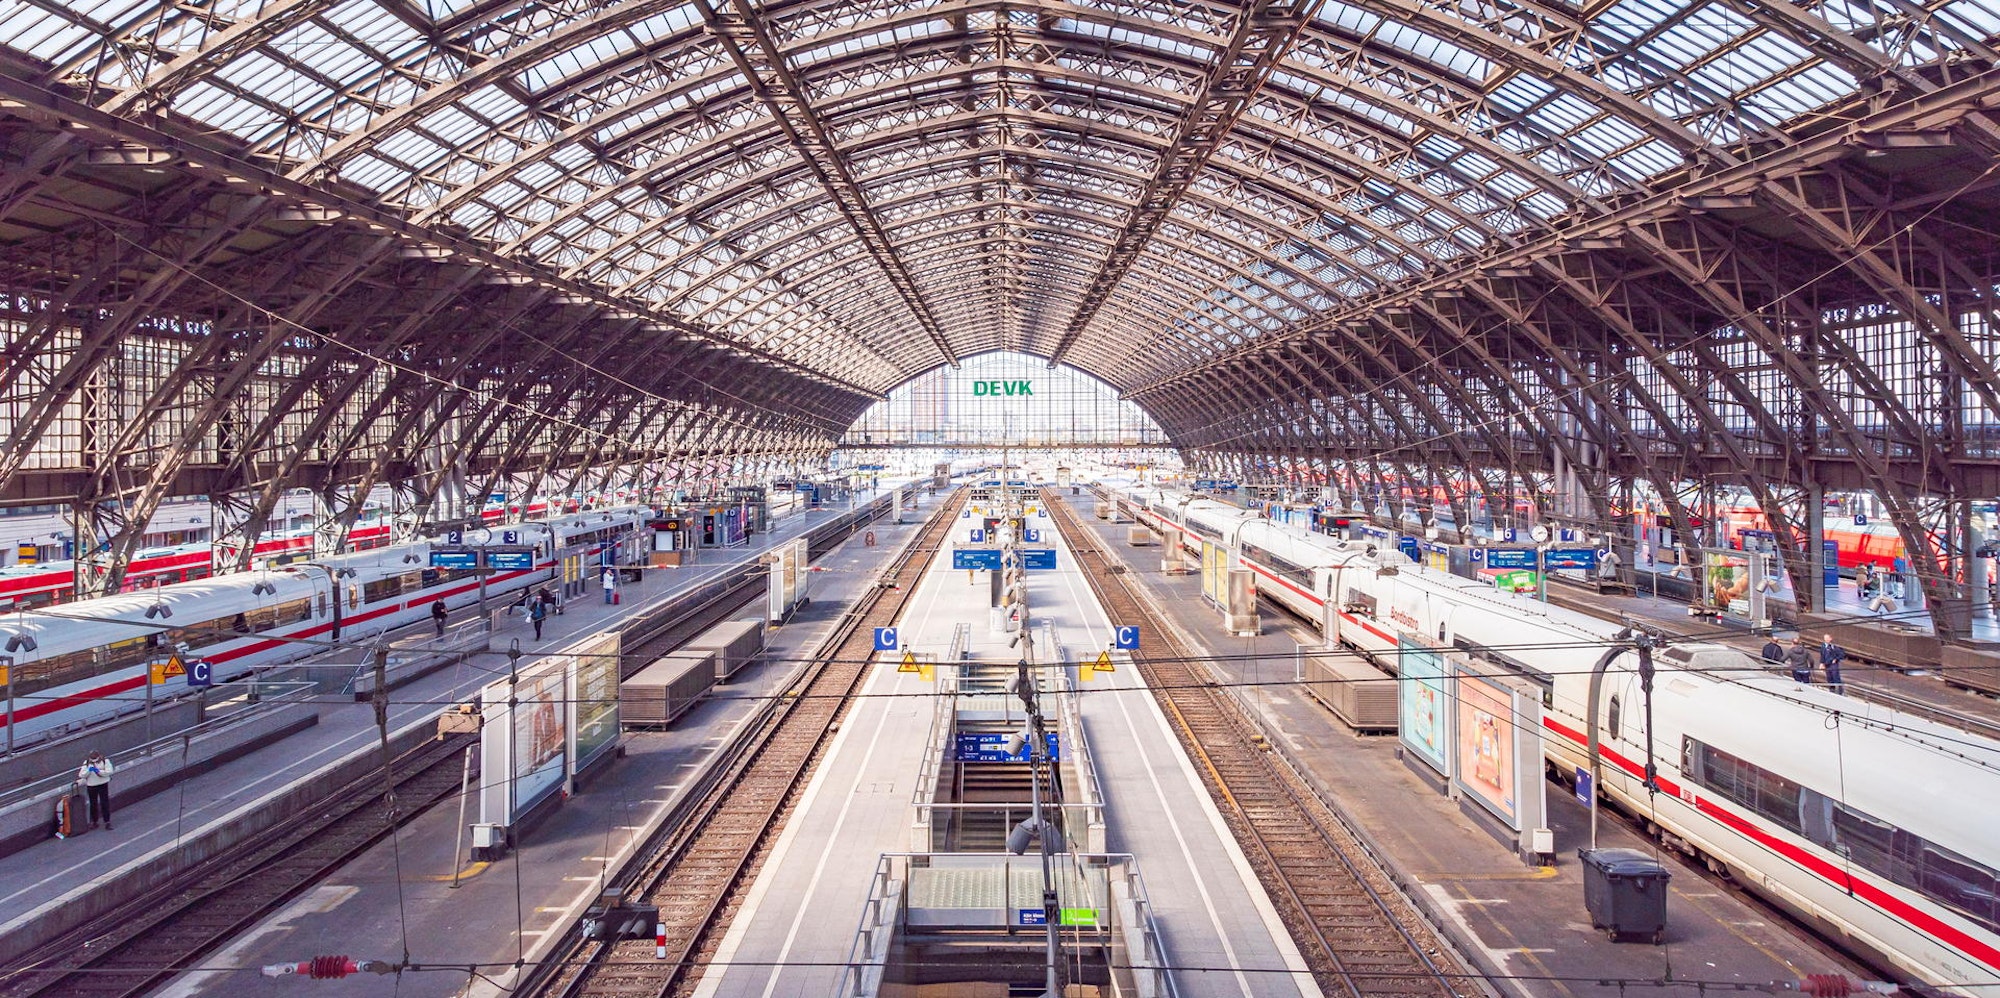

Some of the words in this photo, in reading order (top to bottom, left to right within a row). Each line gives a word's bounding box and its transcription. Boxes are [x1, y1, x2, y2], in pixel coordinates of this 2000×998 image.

[973, 381, 1033, 396] DEVK
[1856, 515, 1864, 524] C
[450, 531, 457, 542] 2
[508, 531, 515, 542] 3
[971, 529, 979, 540] 4
[1029, 529, 1037, 540] 5
[1504, 528, 1512, 539] 6
[1566, 528, 1573, 539] 7
[1472, 549, 1481, 560] C
[881, 629, 894, 646] C
[1119, 627, 1132, 645] C
[194, 663, 207, 681] C
[1685, 740, 1692, 755] 2
